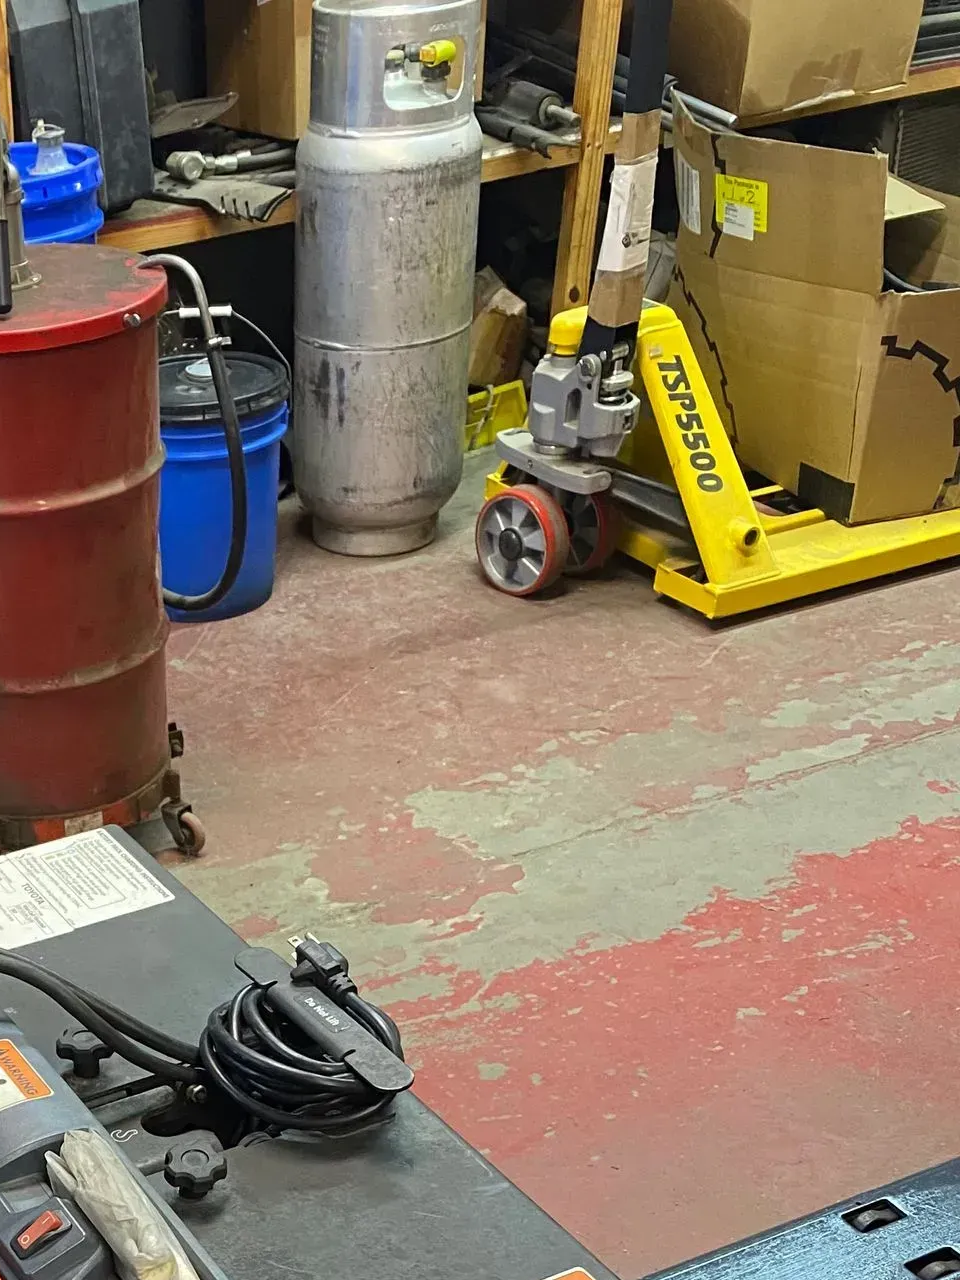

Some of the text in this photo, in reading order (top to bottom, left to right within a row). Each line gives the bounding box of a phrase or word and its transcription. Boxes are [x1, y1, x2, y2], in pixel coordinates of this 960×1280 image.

[657, 354, 724, 493] TSP5500
[21, 883, 44, 904] TOYOTA
[2, 1053, 39, 1096] WARNING
